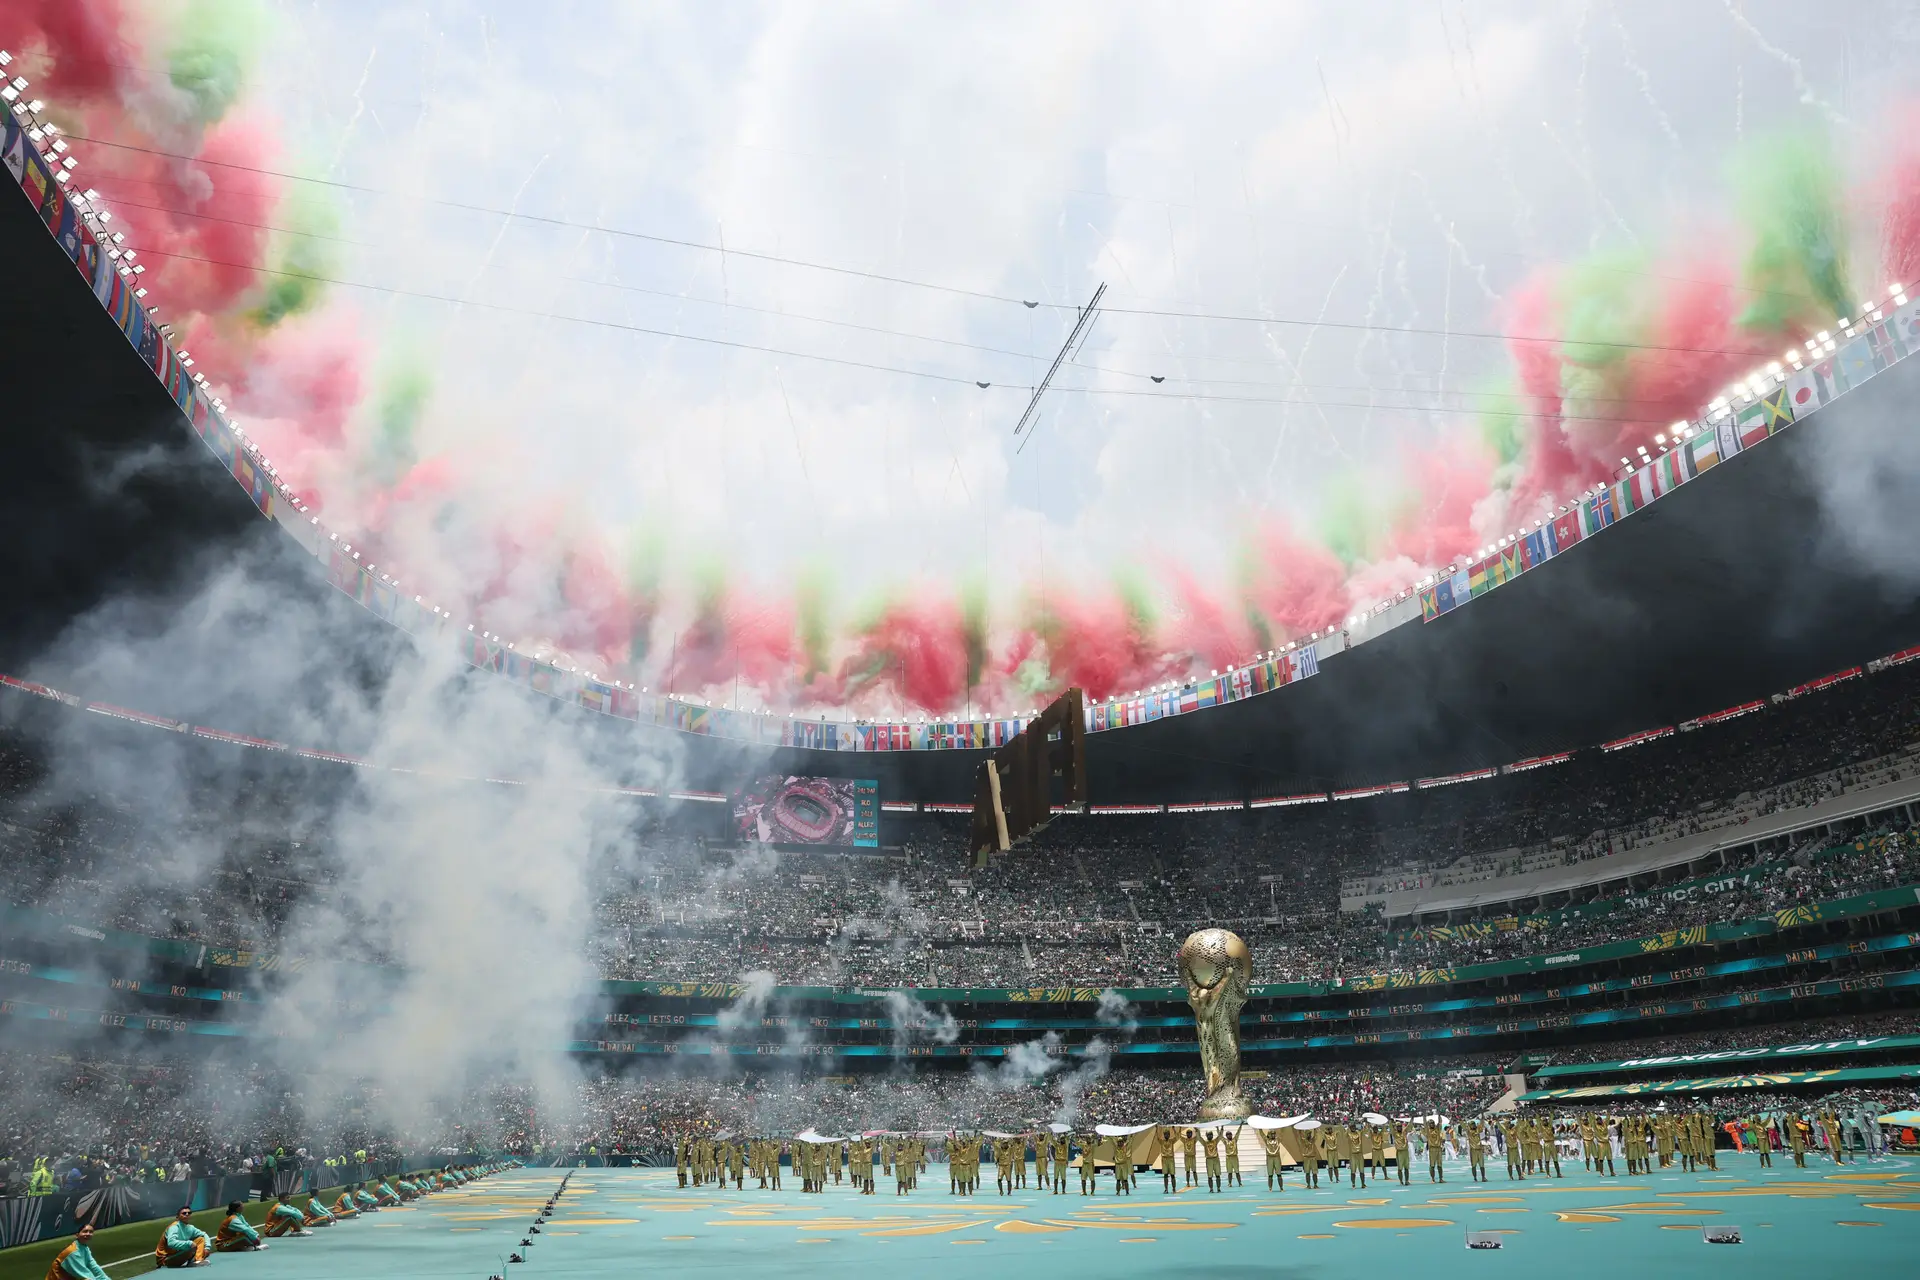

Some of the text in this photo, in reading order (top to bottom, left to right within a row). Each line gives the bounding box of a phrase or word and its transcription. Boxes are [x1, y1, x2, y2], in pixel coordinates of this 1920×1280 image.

[1786, 949, 1817, 963] DAI DAI
[20, 962, 31, 974] GO
[1631, 966, 1706, 987] ALLEZ LET'S GO
[111, 978, 140, 990] DAI DAI
[1588, 982, 1607, 992] DALE
[1790, 976, 1884, 998] ALLEZ LET'S GO
[171, 985, 187, 997] IKO
[222, 991, 243, 1001] DALE
[1244, 987, 1265, 995] ITY
[1547, 988, 1560, 998] IKO
[1495, 993, 1521, 1004] DAI DAI
[1739, 992, 1760, 1004] DALE
[1692, 1000, 1707, 1010] IKO
[1304, 1011, 1321, 1020] DALE
[1348, 1003, 1423, 1018] ALLEZ LET'S GO
[1639, 1005, 1666, 1017] DAI DAI
[100, 1014, 186, 1031] ALLEZ LET'S GO
[604, 1013, 685, 1025] ALLEZ LET'S GO
[761, 1017, 774, 1026] DAI
[815, 1018, 829, 1027] IKO
[859, 1019, 877, 1027] DALE
[966, 1019, 978, 1028] GO
[1260, 1014, 1273, 1023] IKO
[1496, 1016, 1570, 1033] ALLEZ LET'S GO
[1407, 1031, 1421, 1040] IKO
[1451, 1027, 1470, 1037] DALE
[1354, 1034, 1381, 1044] DAI DAI
[607, 1043, 635, 1052] DAI DAI
[663, 1044, 678, 1053] IKO
[756, 1046, 780, 1055] ALLEZ
[822, 1046, 834, 1055] GO
[907, 1047, 933, 1055] DAI DAI
[959, 1047, 973, 1055] IKO
[1046, 1046, 1068, 1054] ALLEZ
[1107, 1044, 1119, 1053] GO
[1618, 1037, 1890, 1067] MEXICO CITY
